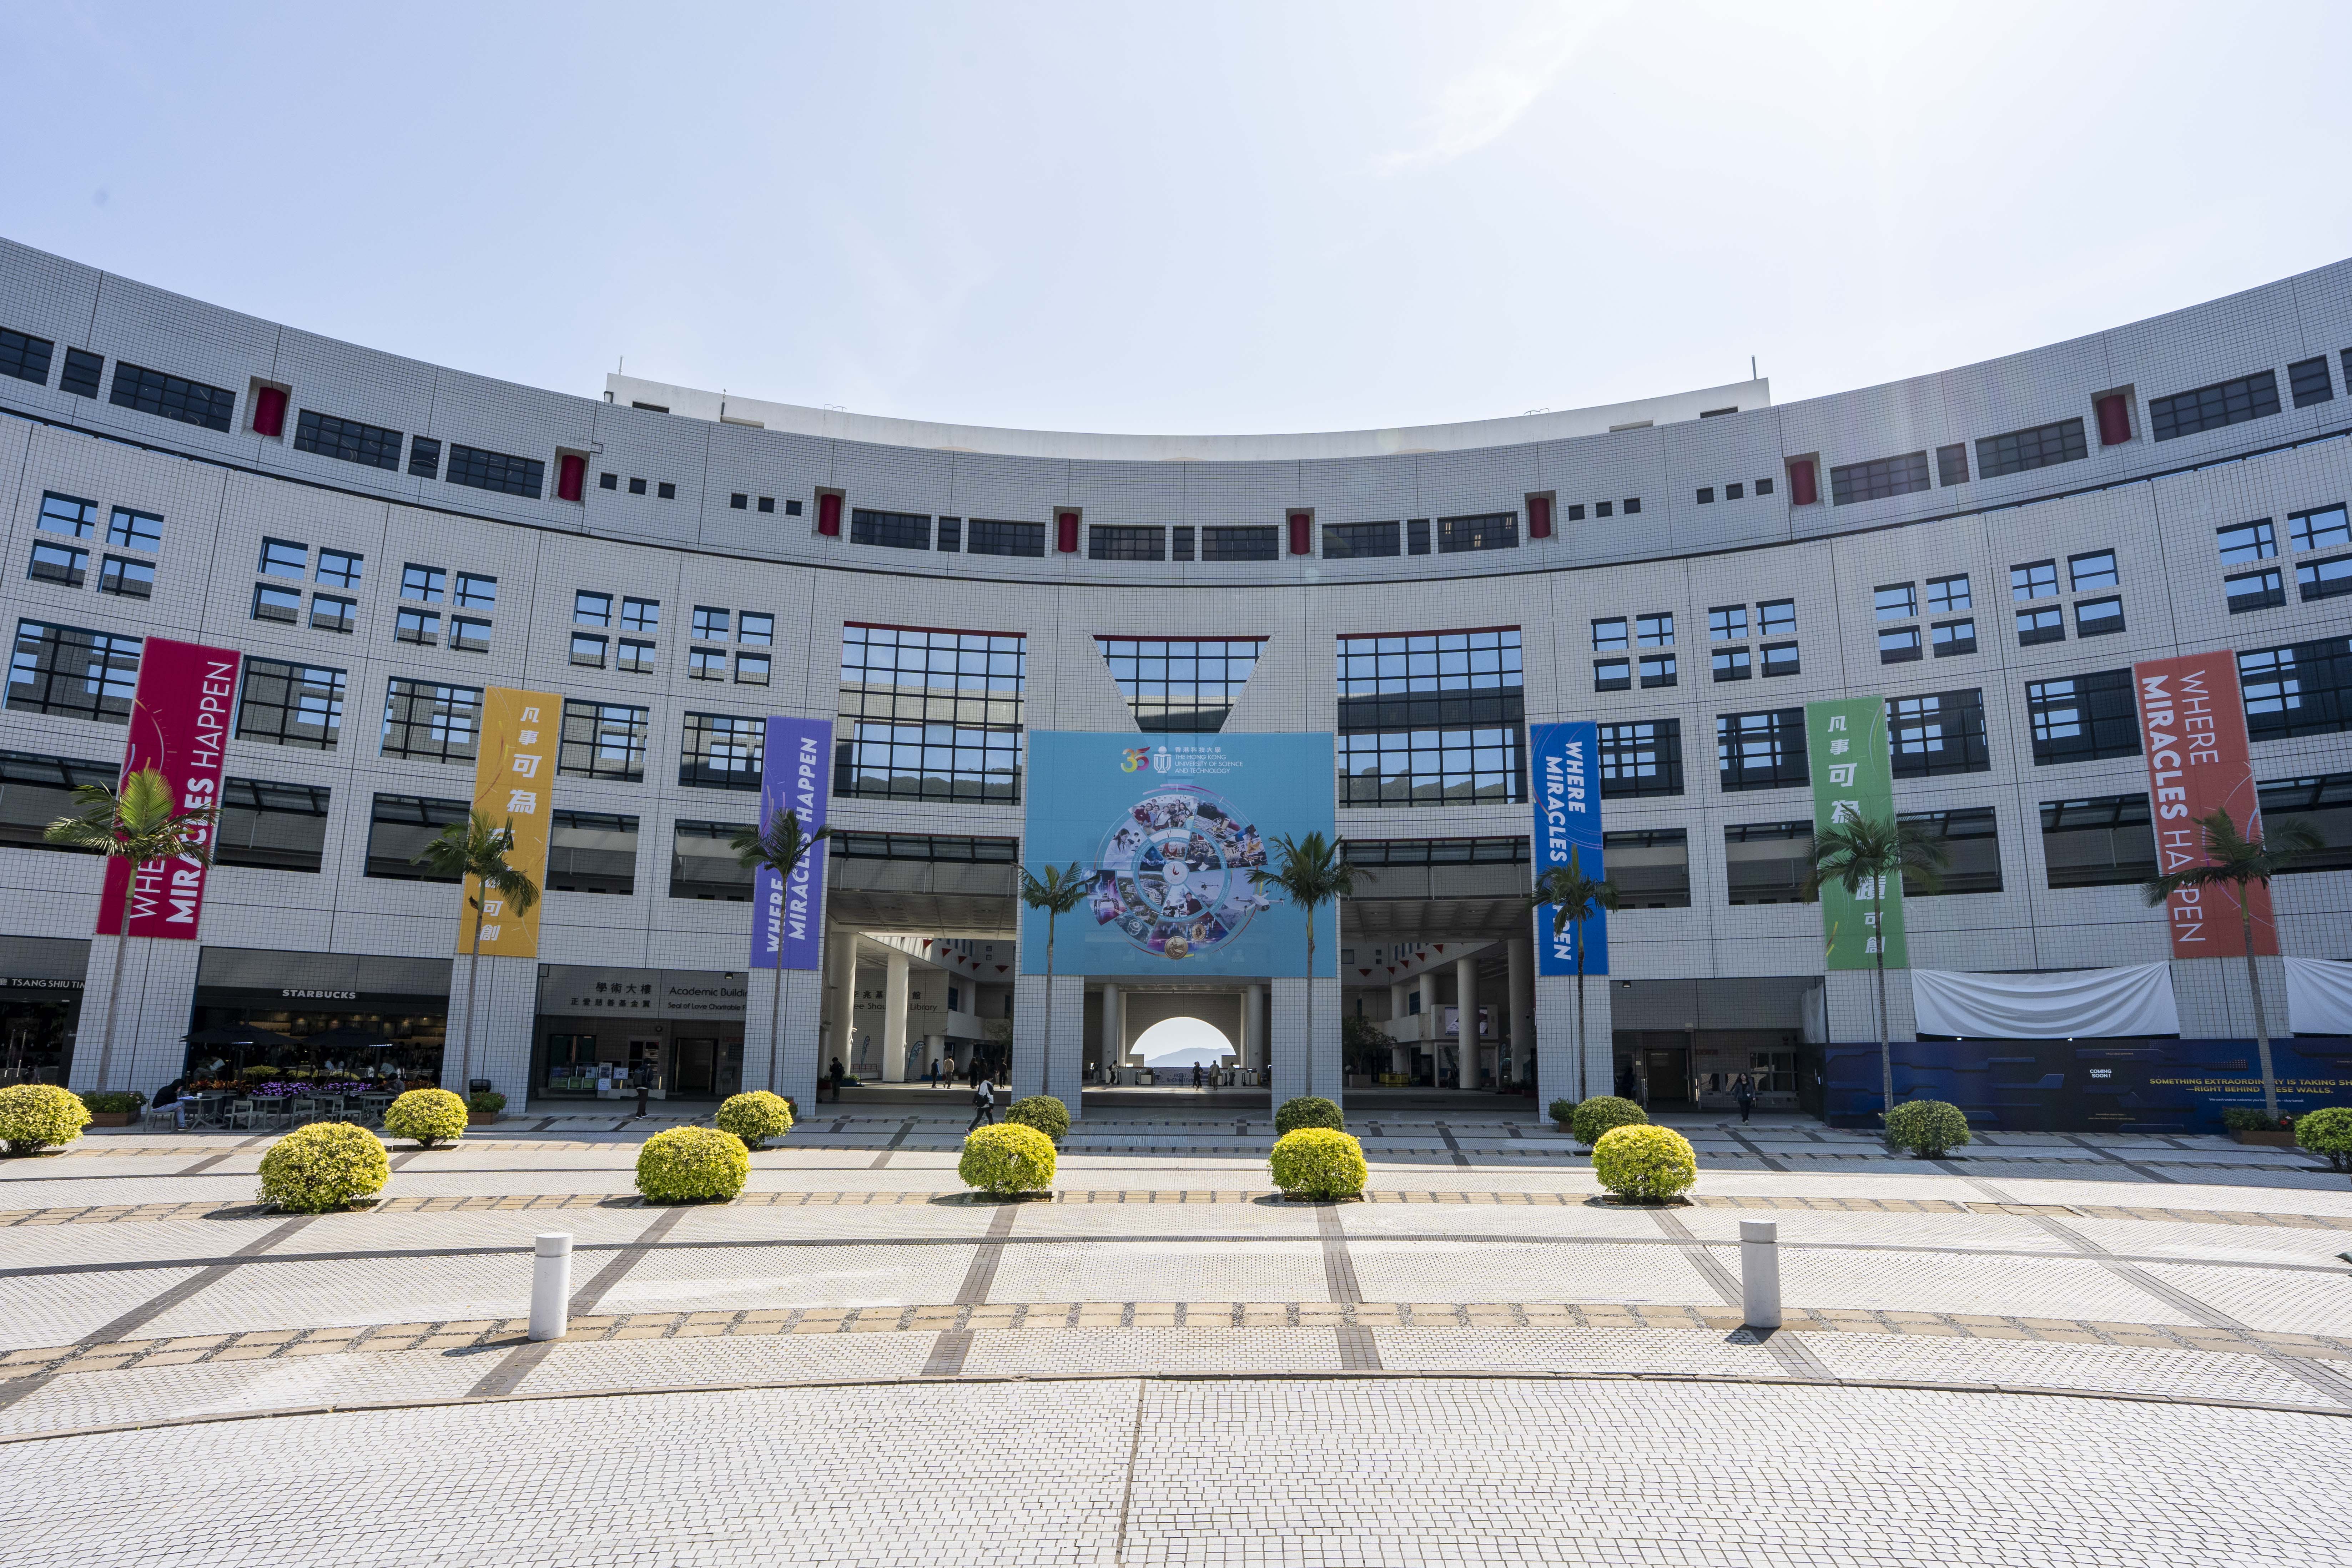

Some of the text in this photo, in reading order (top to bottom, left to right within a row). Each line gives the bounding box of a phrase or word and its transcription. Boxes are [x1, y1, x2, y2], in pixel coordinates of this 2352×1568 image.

[191, 661, 233, 768] HAPPEN
[2179, 670, 2219, 766] WHERE
[507, 707, 543, 814] 凡事可為
[797, 737, 817, 822] HAPPEN
[1565, 741, 1586, 813] WHERE
[1546, 756, 1567, 862] MIRACLES
[2142, 675, 2206, 942] MIRACLES HAPEN
[767, 878, 788, 952] WHERE
[12, 979, 46, 987] TSANG
[282, 989, 356, 999] STARBUCKS
[596, 982, 652, 994] 學術大樓
[669, 986, 718, 996] Academic
[910, 1003, 937, 1012] Library
